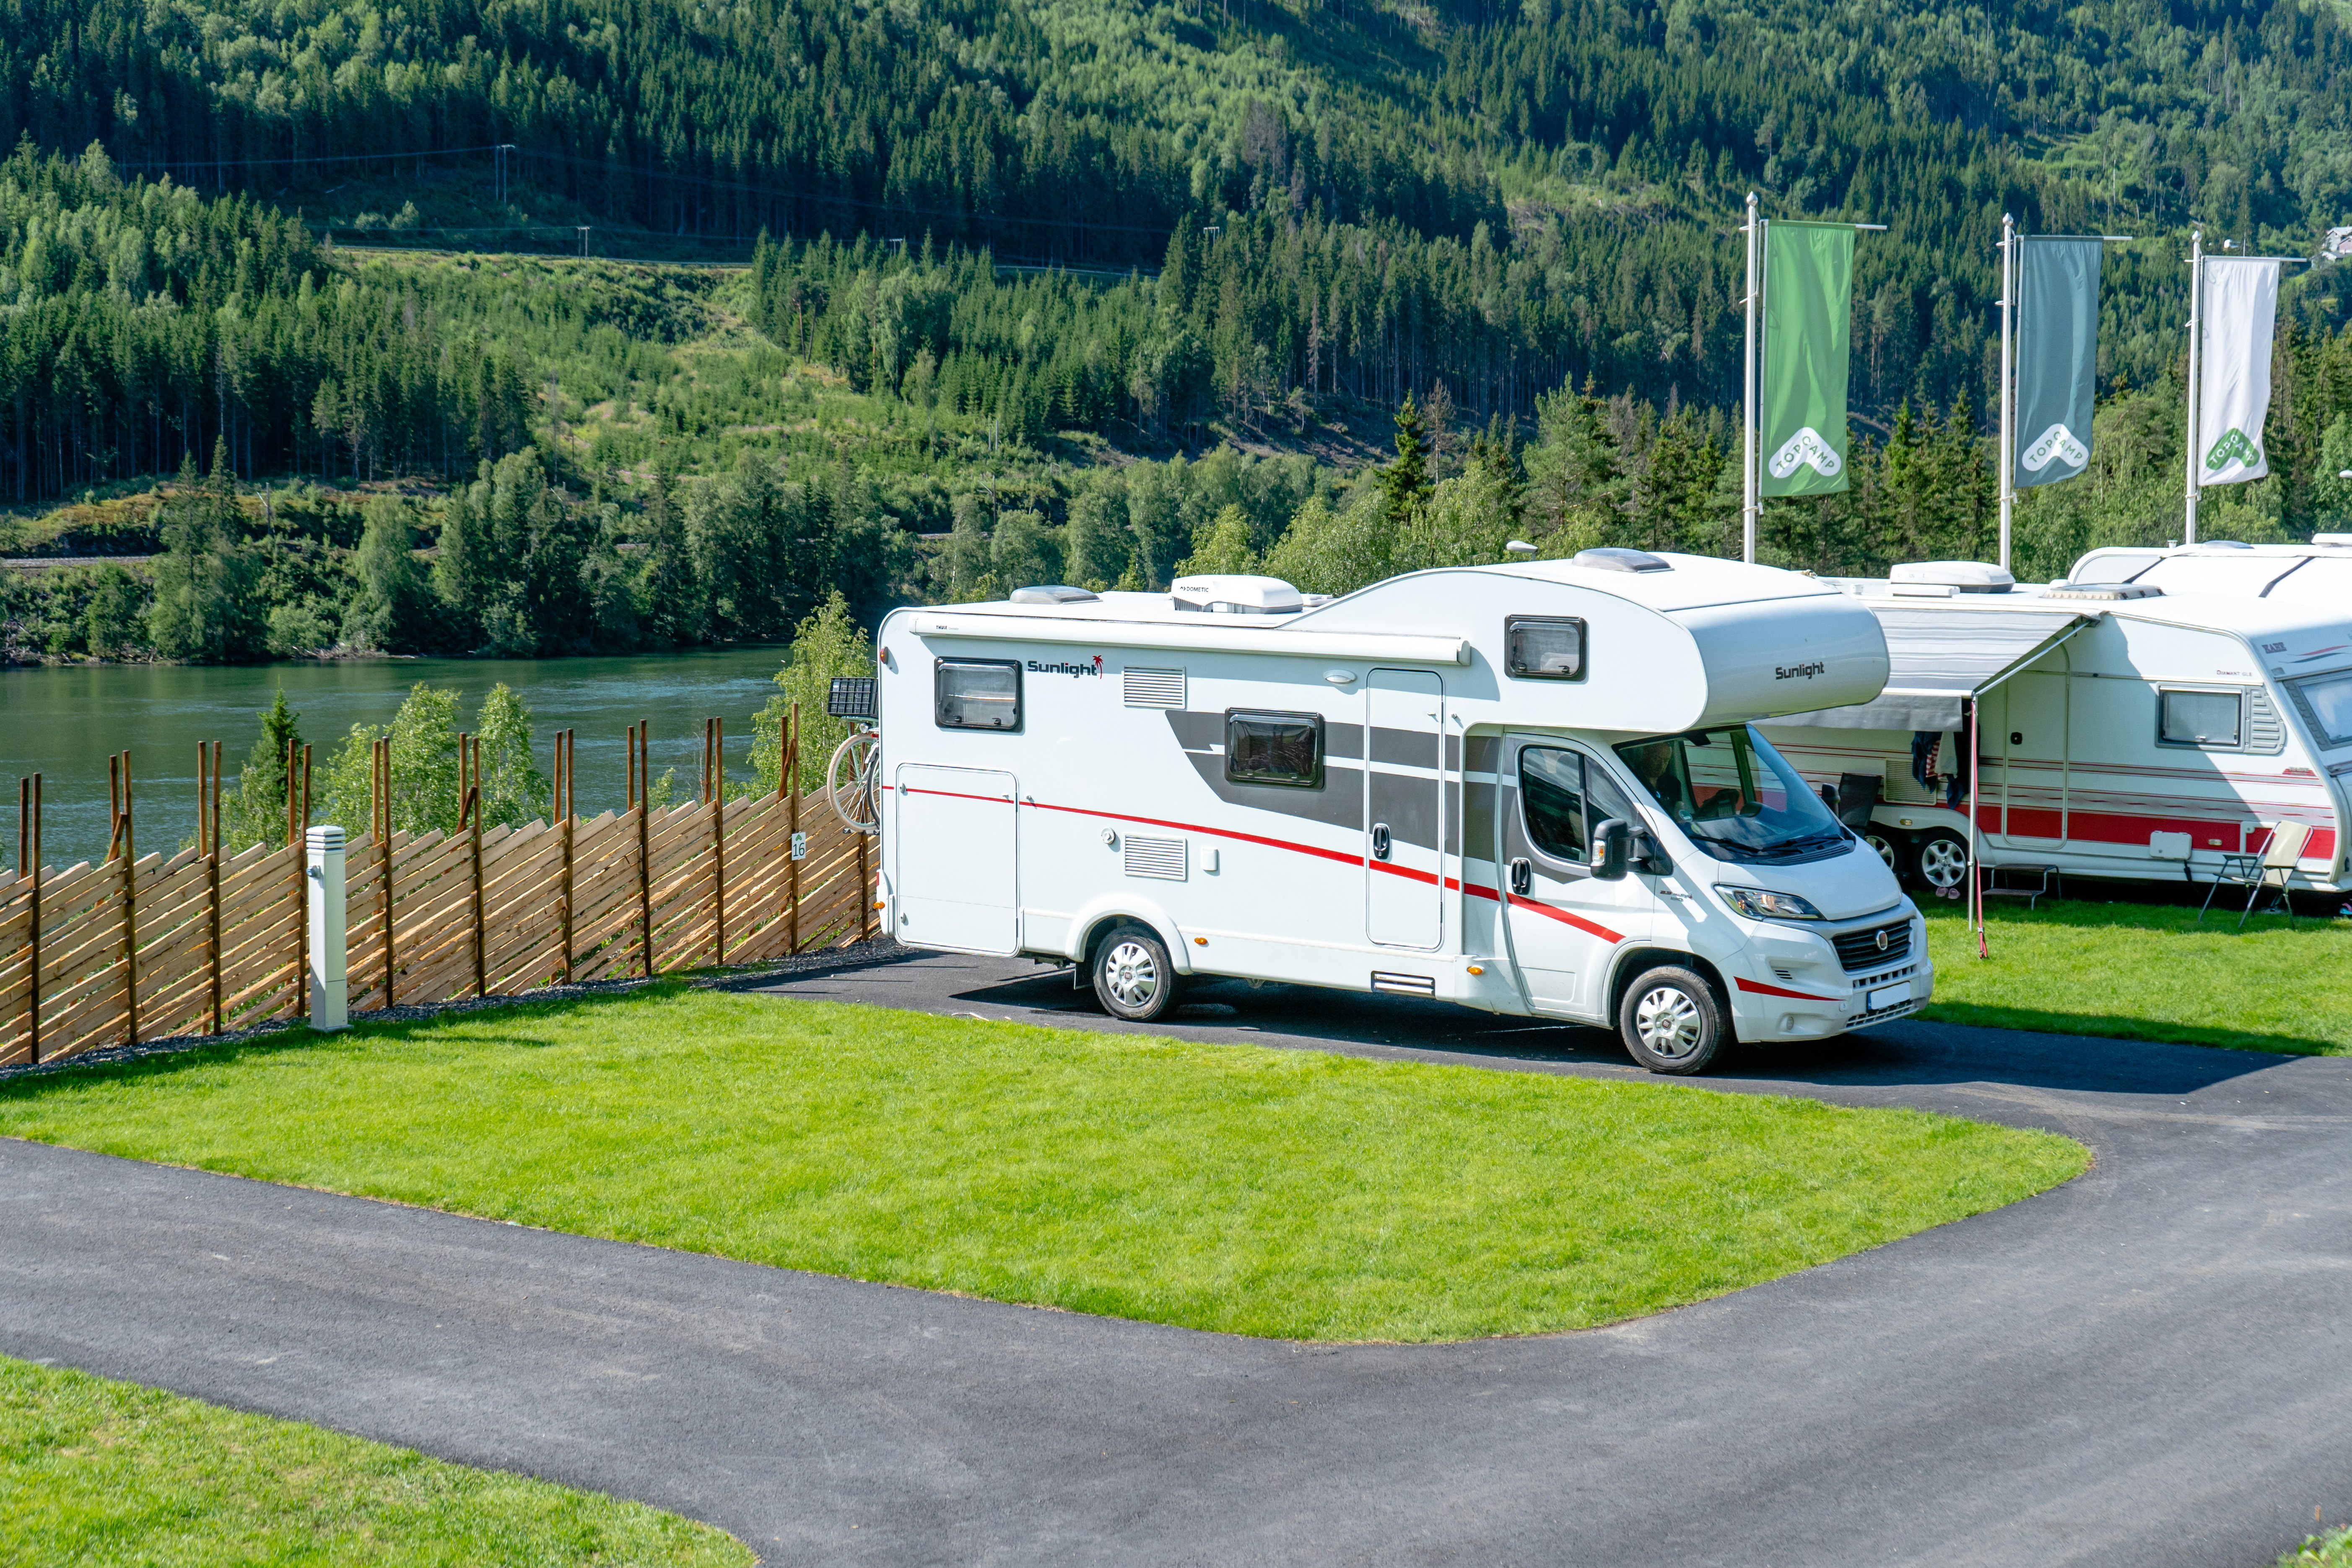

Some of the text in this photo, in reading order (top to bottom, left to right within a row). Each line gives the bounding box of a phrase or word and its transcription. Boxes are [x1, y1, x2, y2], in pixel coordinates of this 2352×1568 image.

[1776, 436, 1835, 470] TOPCAMP
[2029, 431, 2083, 463] TOPCAMP
[1028, 660, 1097, 678] Sunlight
[1776, 662, 1825, 680] Sunlight
[793, 843, 805, 857] 16
